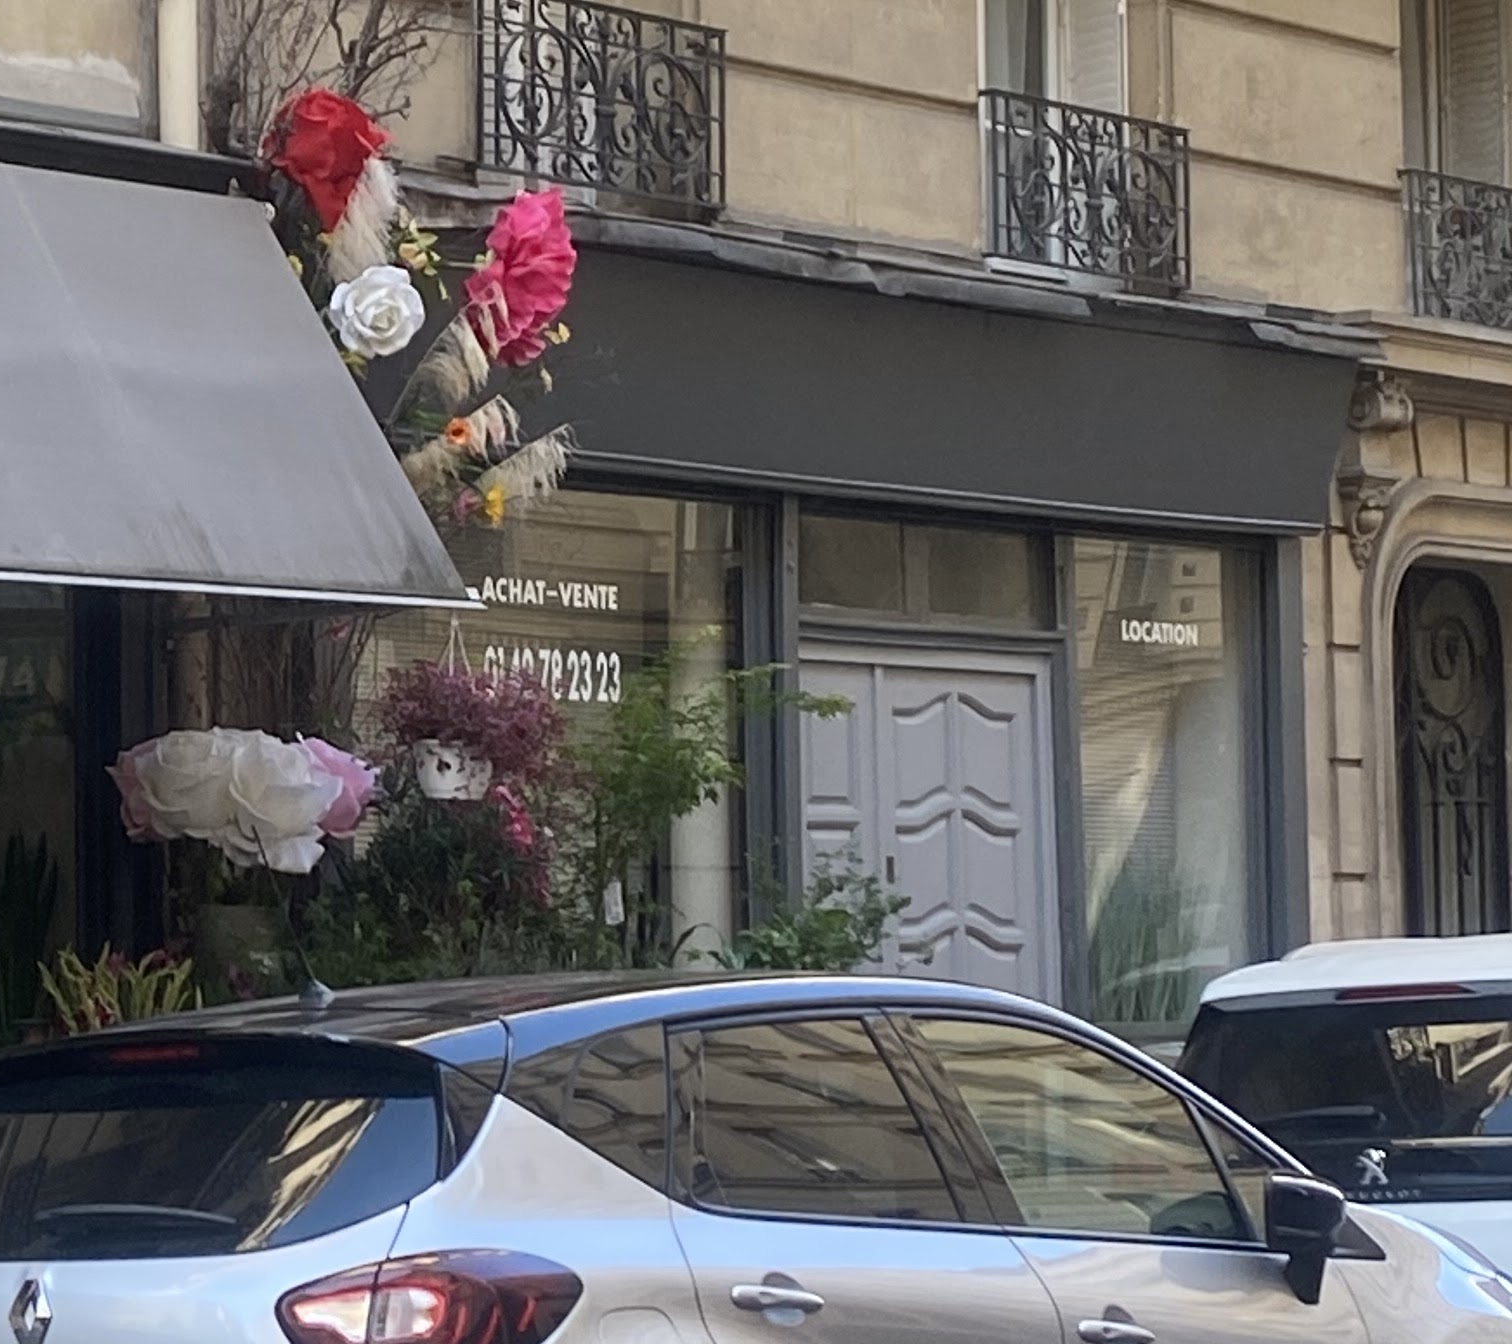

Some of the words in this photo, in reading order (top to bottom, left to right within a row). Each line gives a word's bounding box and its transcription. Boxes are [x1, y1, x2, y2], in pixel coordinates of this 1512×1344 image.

[482, 576, 618, 610] ACHAT-VENTE
[1121, 619, 1198, 646] LOCATION
[567, 650, 592, 702] 23
[596, 652, 621, 702] 23
